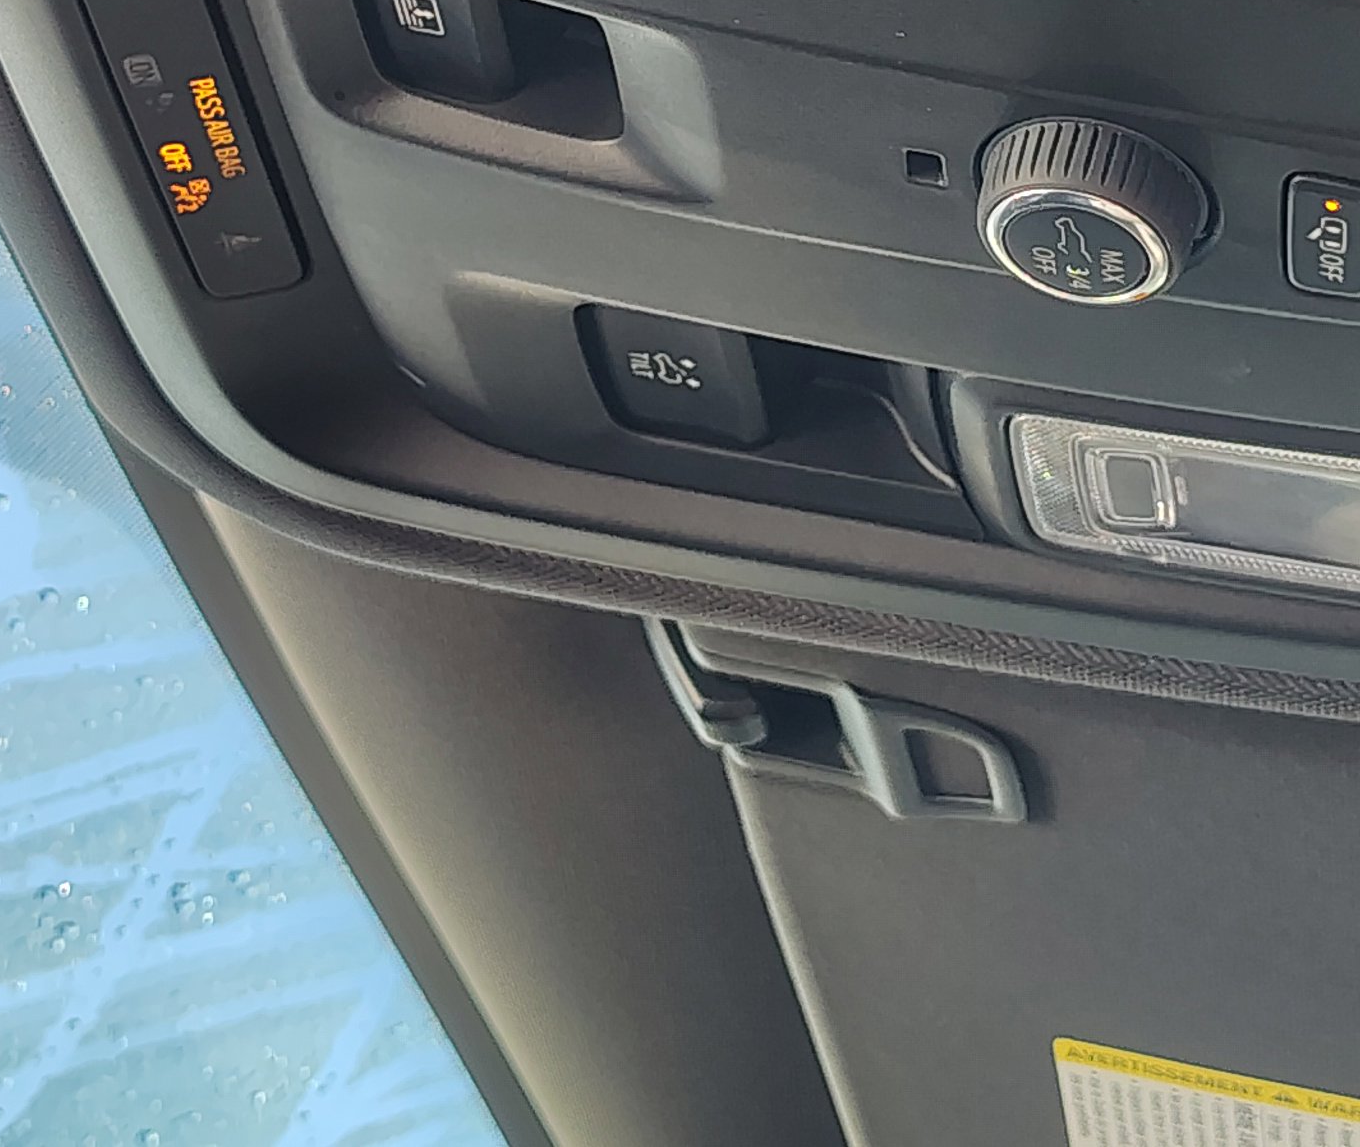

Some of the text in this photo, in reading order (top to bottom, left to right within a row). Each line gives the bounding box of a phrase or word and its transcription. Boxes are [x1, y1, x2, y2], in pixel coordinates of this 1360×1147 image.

[189, 77, 246, 180] PASS AIR BAG
[159, 143, 193, 173] OFF
[1031, 246, 1057, 275] OFF
[1099, 249, 1125, 285] MAX
[1317, 252, 1347, 283] OFF
[1065, 264, 1091, 291] 3/4
[1066, 1045, 1265, 1097] AVERTISSEMENT
